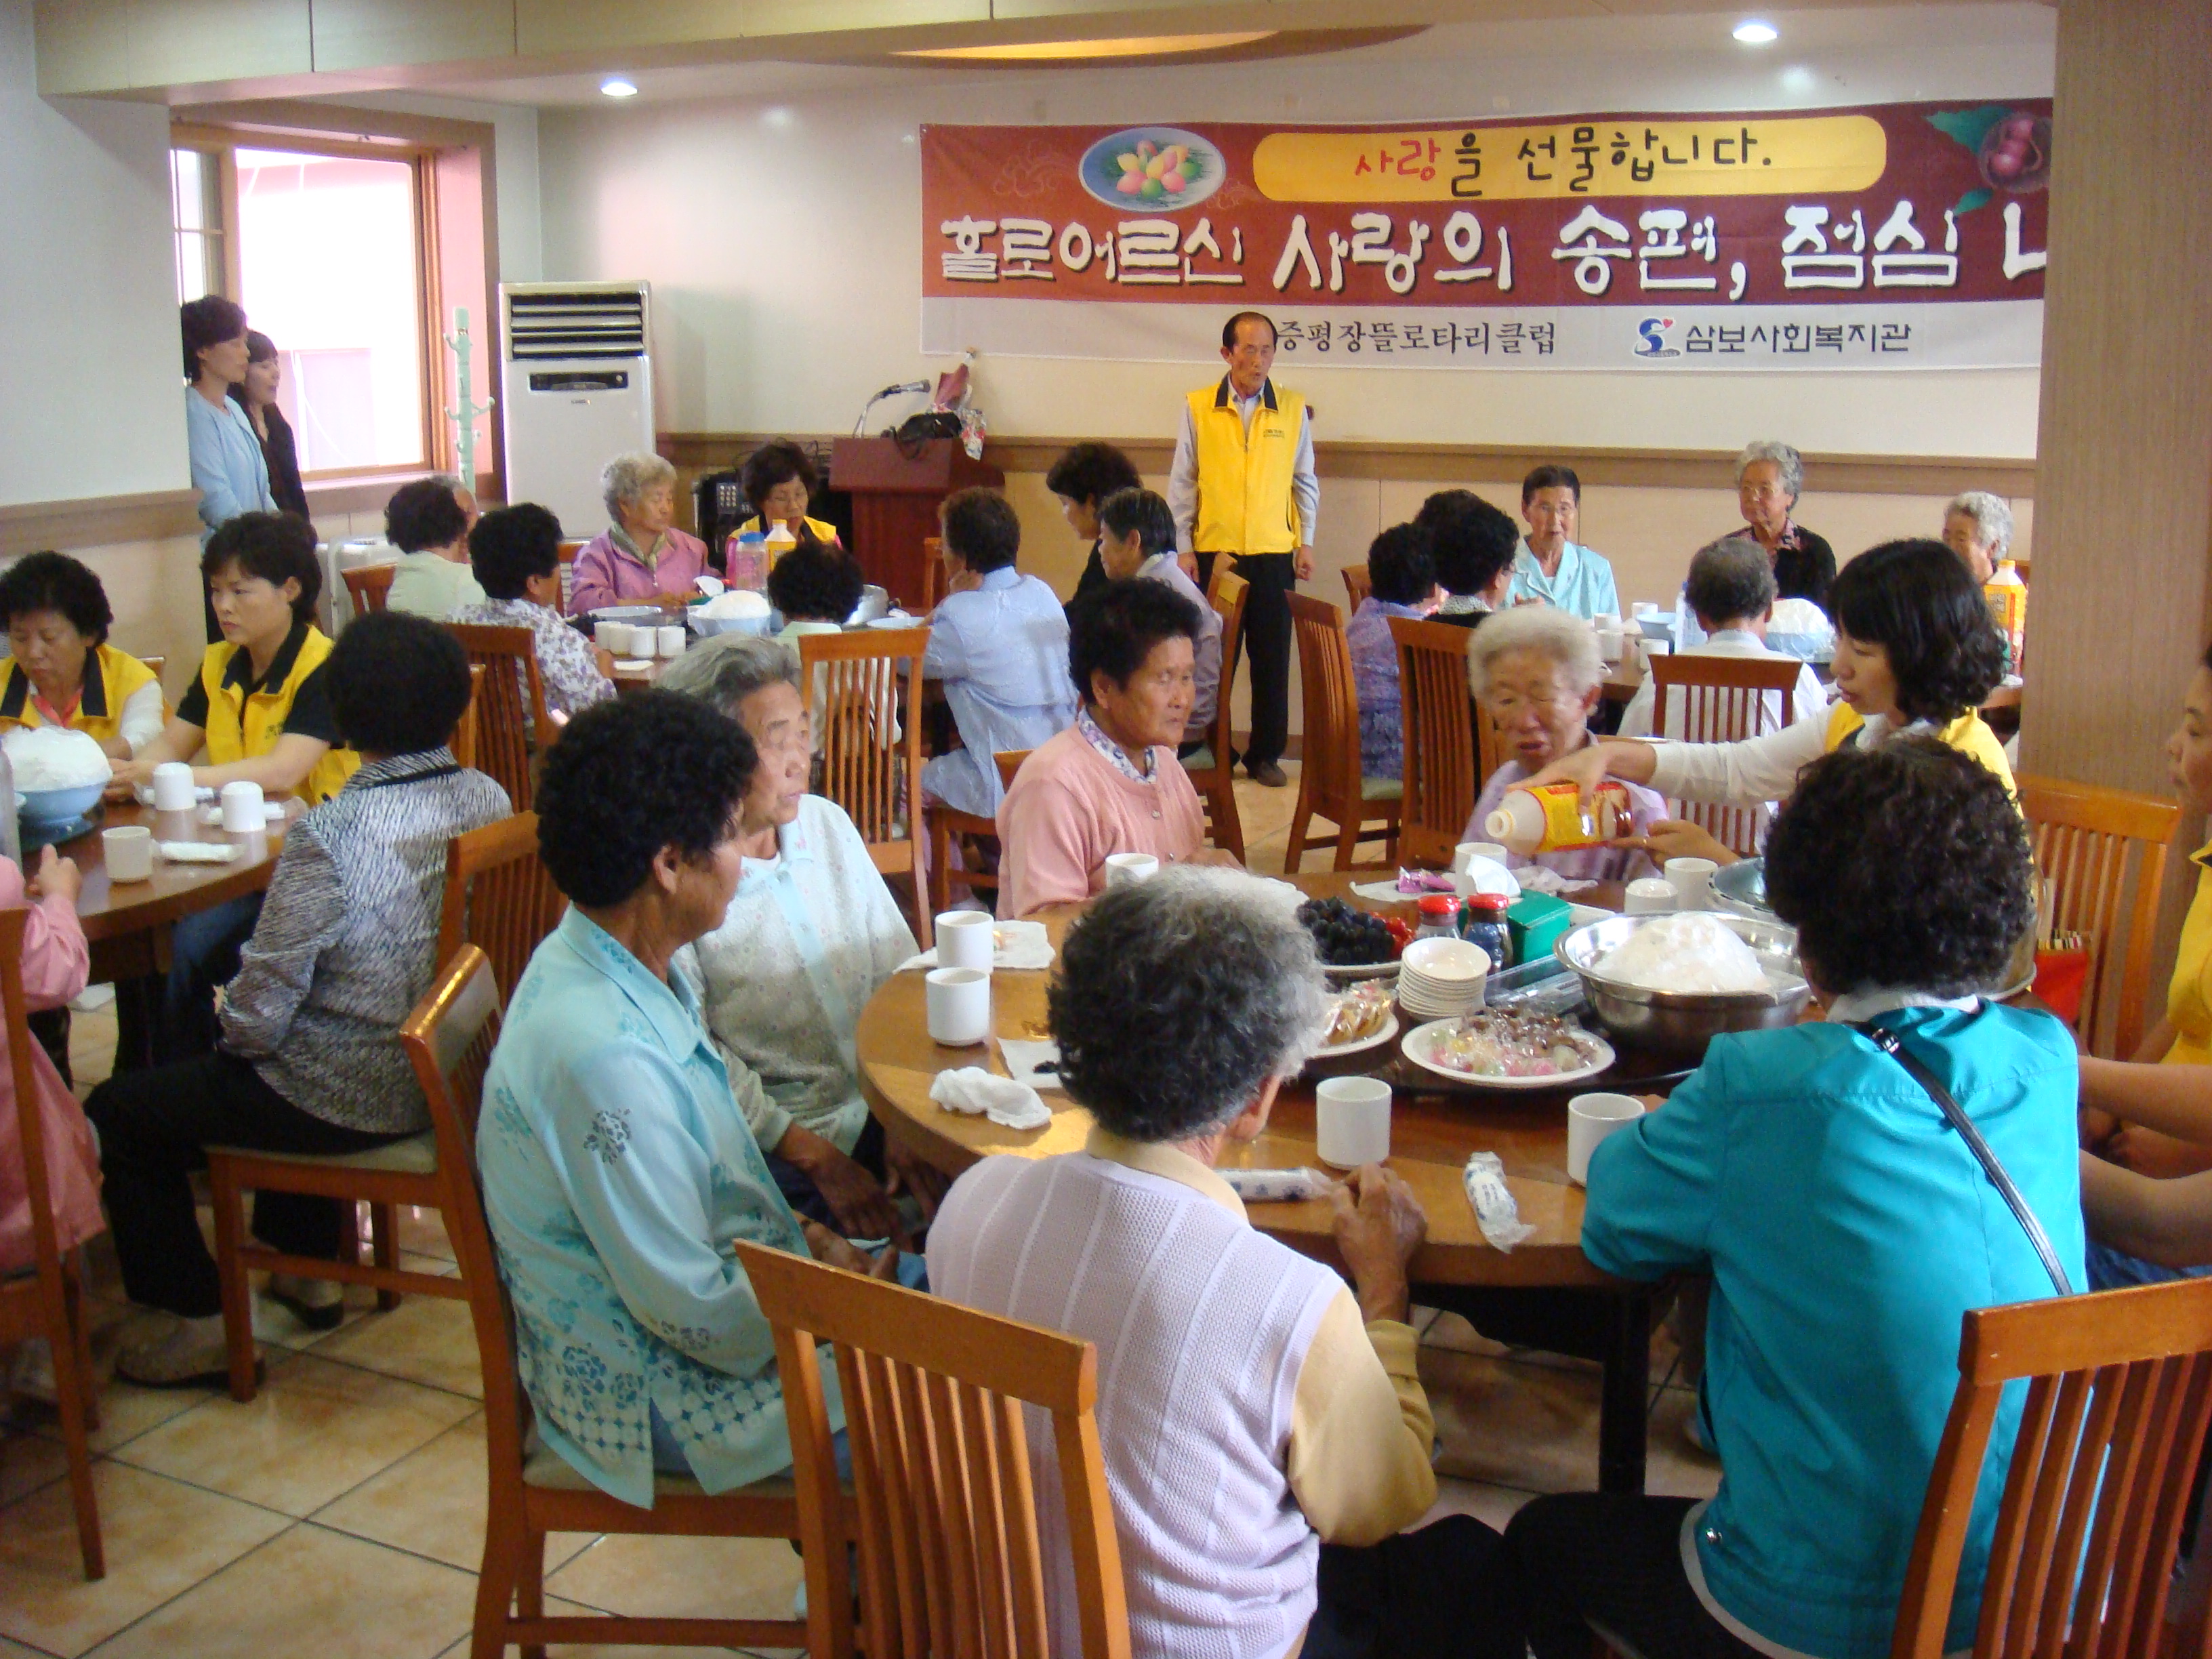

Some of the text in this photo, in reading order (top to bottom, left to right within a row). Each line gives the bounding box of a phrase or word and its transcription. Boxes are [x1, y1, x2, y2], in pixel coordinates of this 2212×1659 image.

[1355, 125, 1771, 198] 사랑을 선물합니다.
[940, 214, 1244, 283] 홀로어르신
[1272, 211, 1513, 293] 사랑의
[1552, 205, 1748, 301] 송편,
[1781, 200, 1959, 289] 점심
[1277, 321, 1555, 355] 증평장뜰로타리클럽
[1686, 323, 1912, 353] 삼보사회복지관
